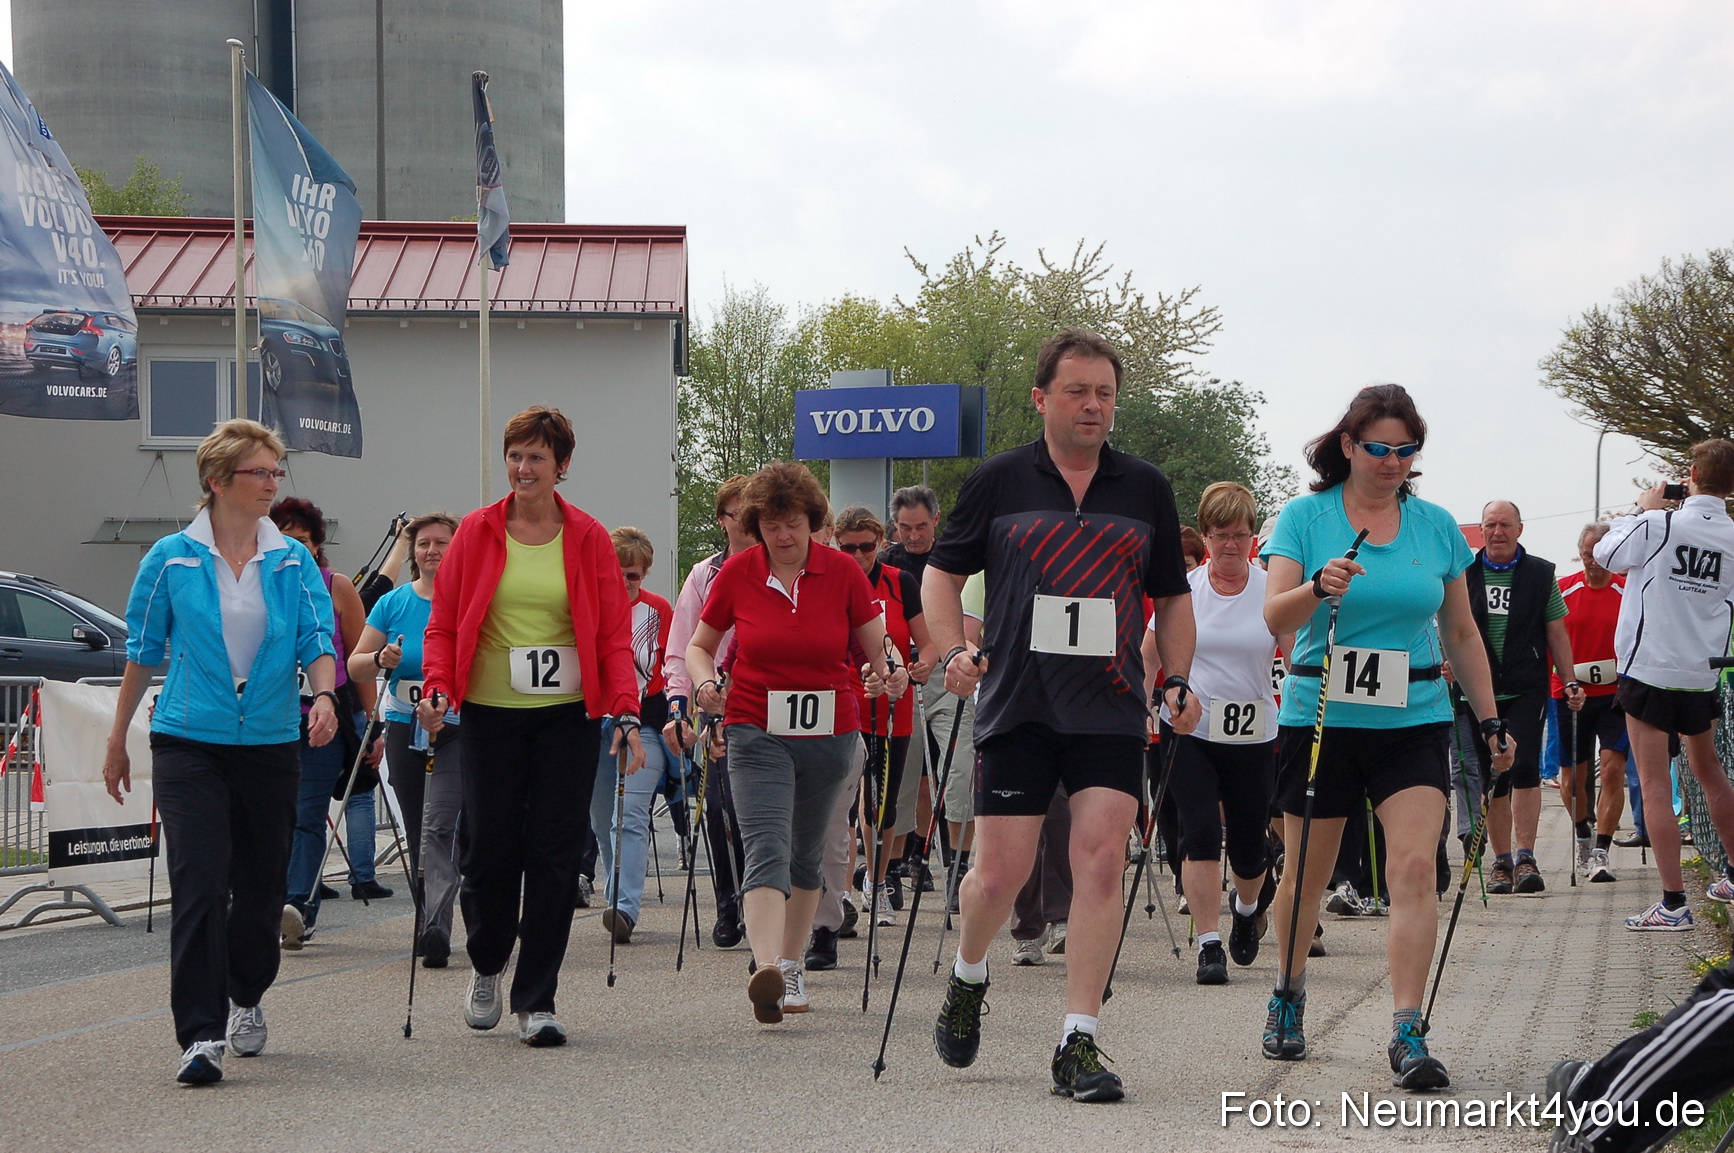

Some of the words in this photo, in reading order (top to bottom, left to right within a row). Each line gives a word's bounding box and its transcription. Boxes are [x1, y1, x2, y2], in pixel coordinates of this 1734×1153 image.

[291, 173, 337, 212] IHR
[18, 196, 93, 236] VOLVO
[51, 232, 105, 268] V40.
[58, 268, 79, 285] IT'S
[80, 271, 105, 289] YOU!
[46, 385, 107, 397] VOLVOCARS.DE
[299, 417, 352, 435] VOLVOCARS.DE
[810, 407, 935, 434] VOLVO
[1671, 545, 1722, 582] SVA
[1065, 602, 1080, 647] 1
[526, 649, 561, 688] 12
[1342, 650, 1381, 697] 14
[1589, 665, 1603, 684] 6
[786, 693, 820, 730] 10
[1222, 703, 1256, 736] 82
